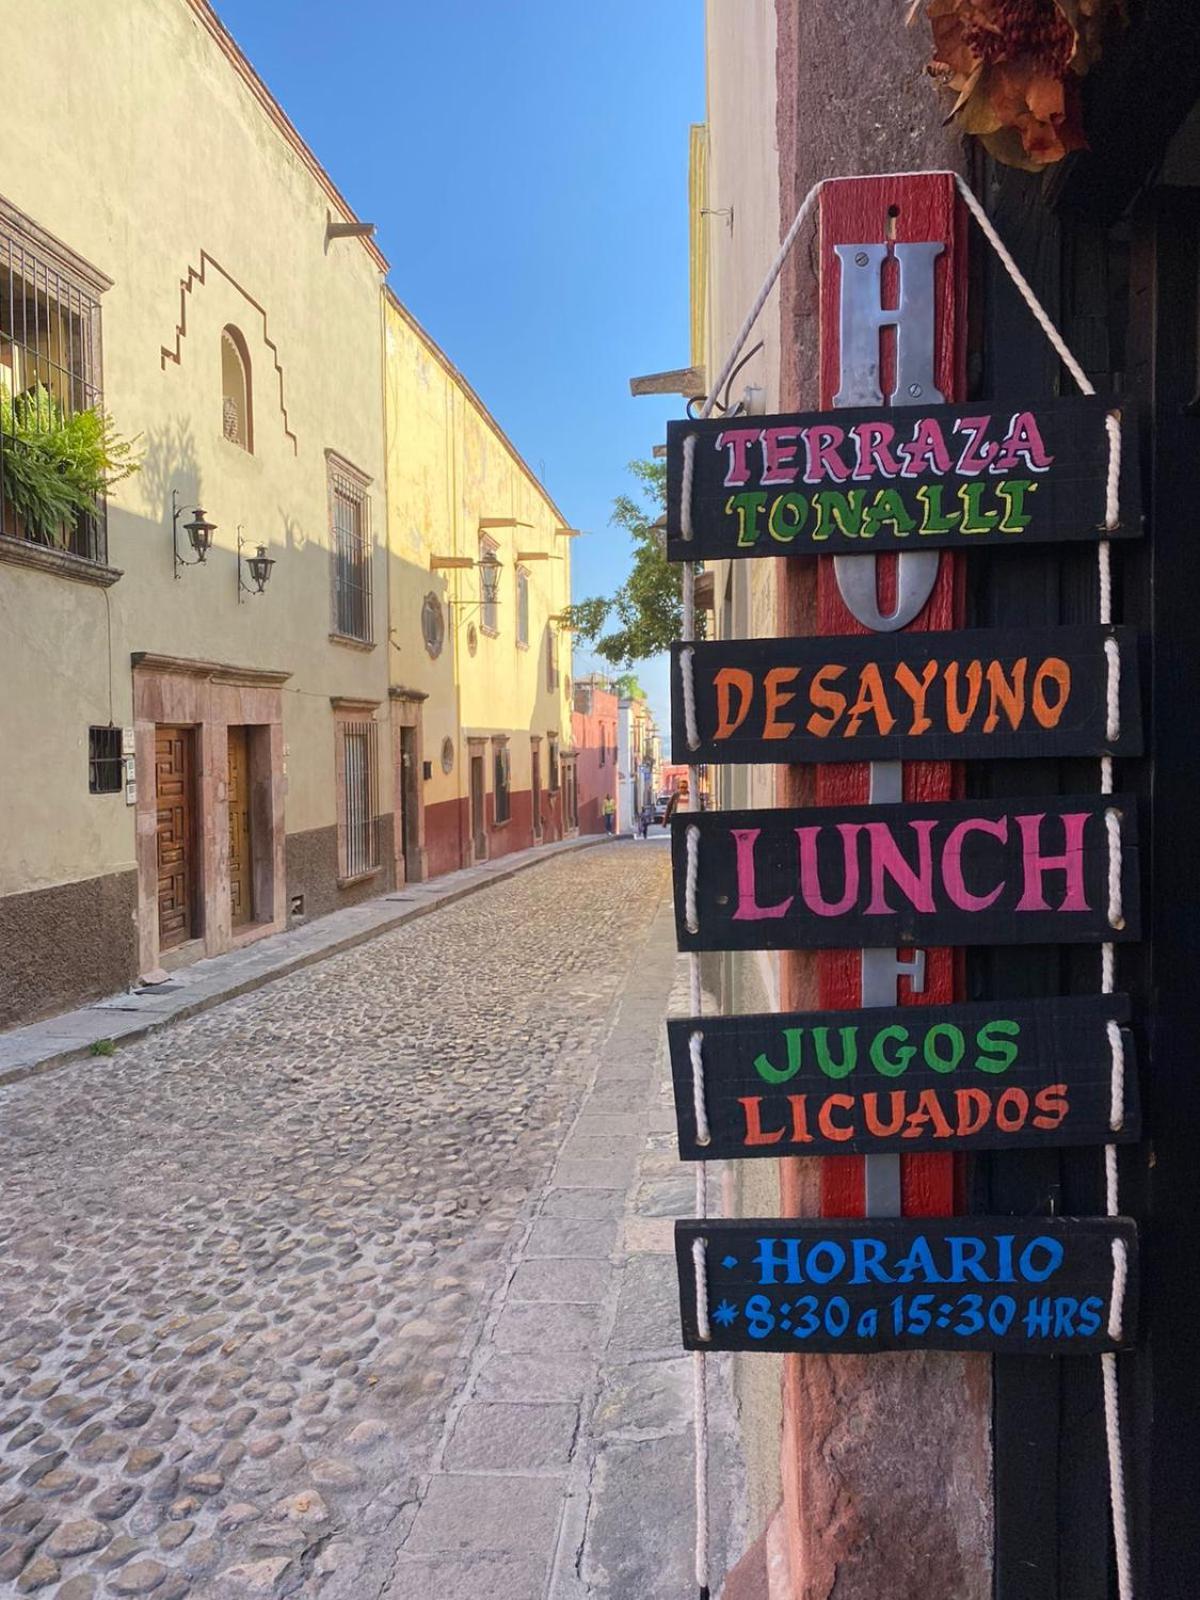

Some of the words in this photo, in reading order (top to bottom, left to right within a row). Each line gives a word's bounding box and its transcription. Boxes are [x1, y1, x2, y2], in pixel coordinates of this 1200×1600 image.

[714, 411, 1054, 488] TERRAZA
[725, 480, 1038, 547] TONALLI
[713, 656, 1071, 740] DESAYUNO
[730, 812, 1093, 921] LUNCH
[753, 1020, 1021, 1084] JUGOS
[738, 1083, 1069, 1146] LICUADOS
[752, 1235, 1064, 1285] HORARIO
[856, 1308, 878, 1338] a
[890, 1294, 1017, 1338] 15:30
[1022, 1296, 1104, 1338] HRS
